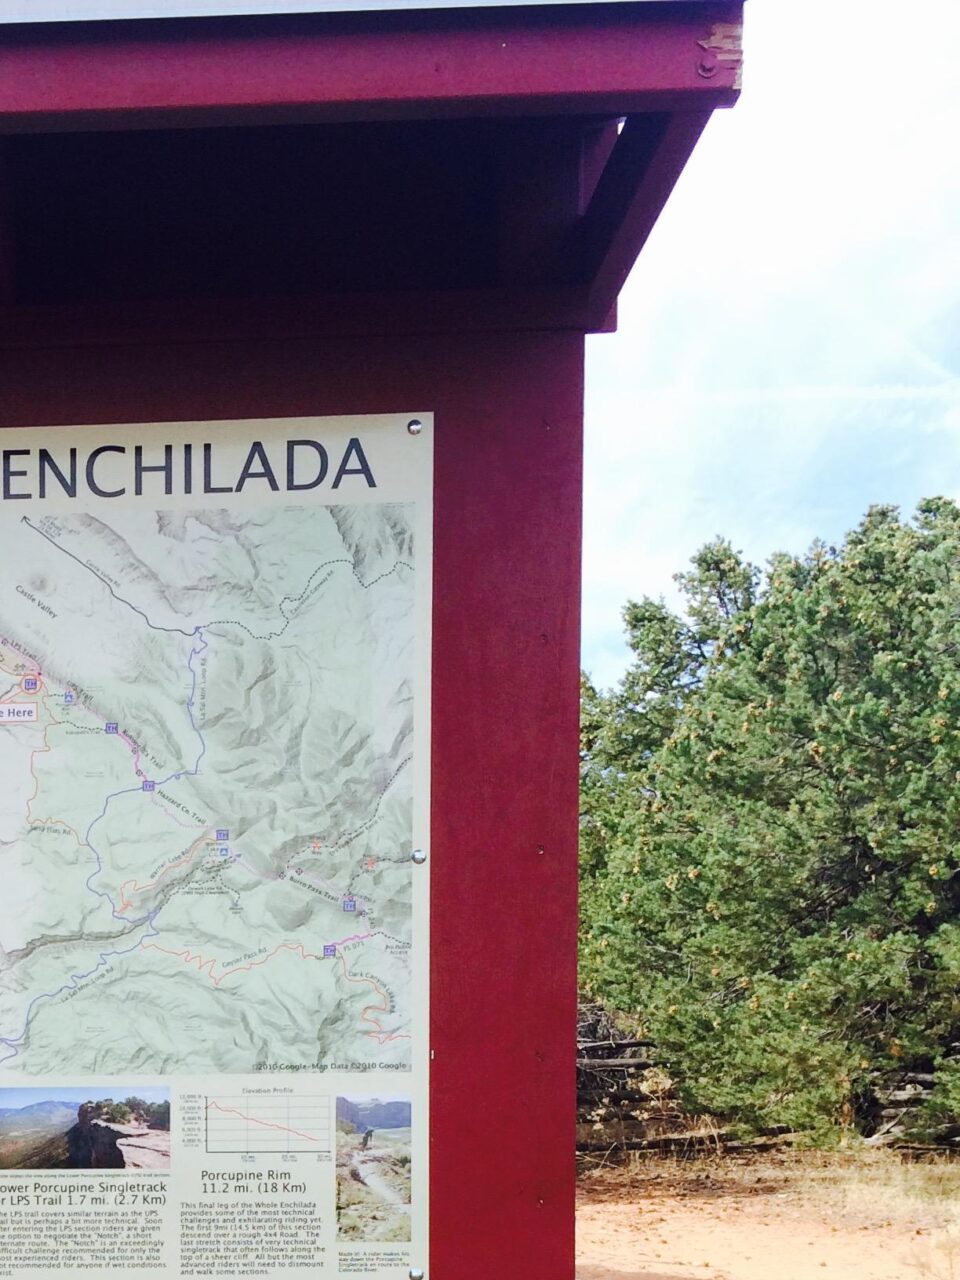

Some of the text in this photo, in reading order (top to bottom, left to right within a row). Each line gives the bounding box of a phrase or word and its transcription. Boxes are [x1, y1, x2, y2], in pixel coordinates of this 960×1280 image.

[2, 437, 377, 500] ENCHILADA
[15, 584, 58, 619] Castle Valley
[7, 708, 33, 718] Here
[200, 1169, 291, 1184] Porcupine Rim
[33, 1182, 95, 1196] Porcupine
[98, 1181, 167, 1196] Singletrack
[203, 1182, 306, 1196] 11.2 mi. (18 Km)
[10, 1194, 31, 1206] LPS
[35, 1194, 62, 1206] Trail
[68, 1194, 86, 1206] 1.7
[90, 1194, 110, 1206] mi.
[114, 1194, 138, 1208] (2.7
[142, 1193, 167, 1208] Km)
[8, 1210, 23, 1218] LPS
[23, 1210, 39, 1218] trail
[66, 1210, 92, 1218] similar
[93, 1210, 119, 1218] terrain
[129, 1209, 143, 1218] the
[143, 1209, 159, 1218] UPS
[179, 1208, 213, 1218] provides
[236, 1208, 245, 1216] of
[246, 1208, 259, 1216] the
[260, 1208, 280, 1216] most
[280, 1208, 315, 1216] technical
